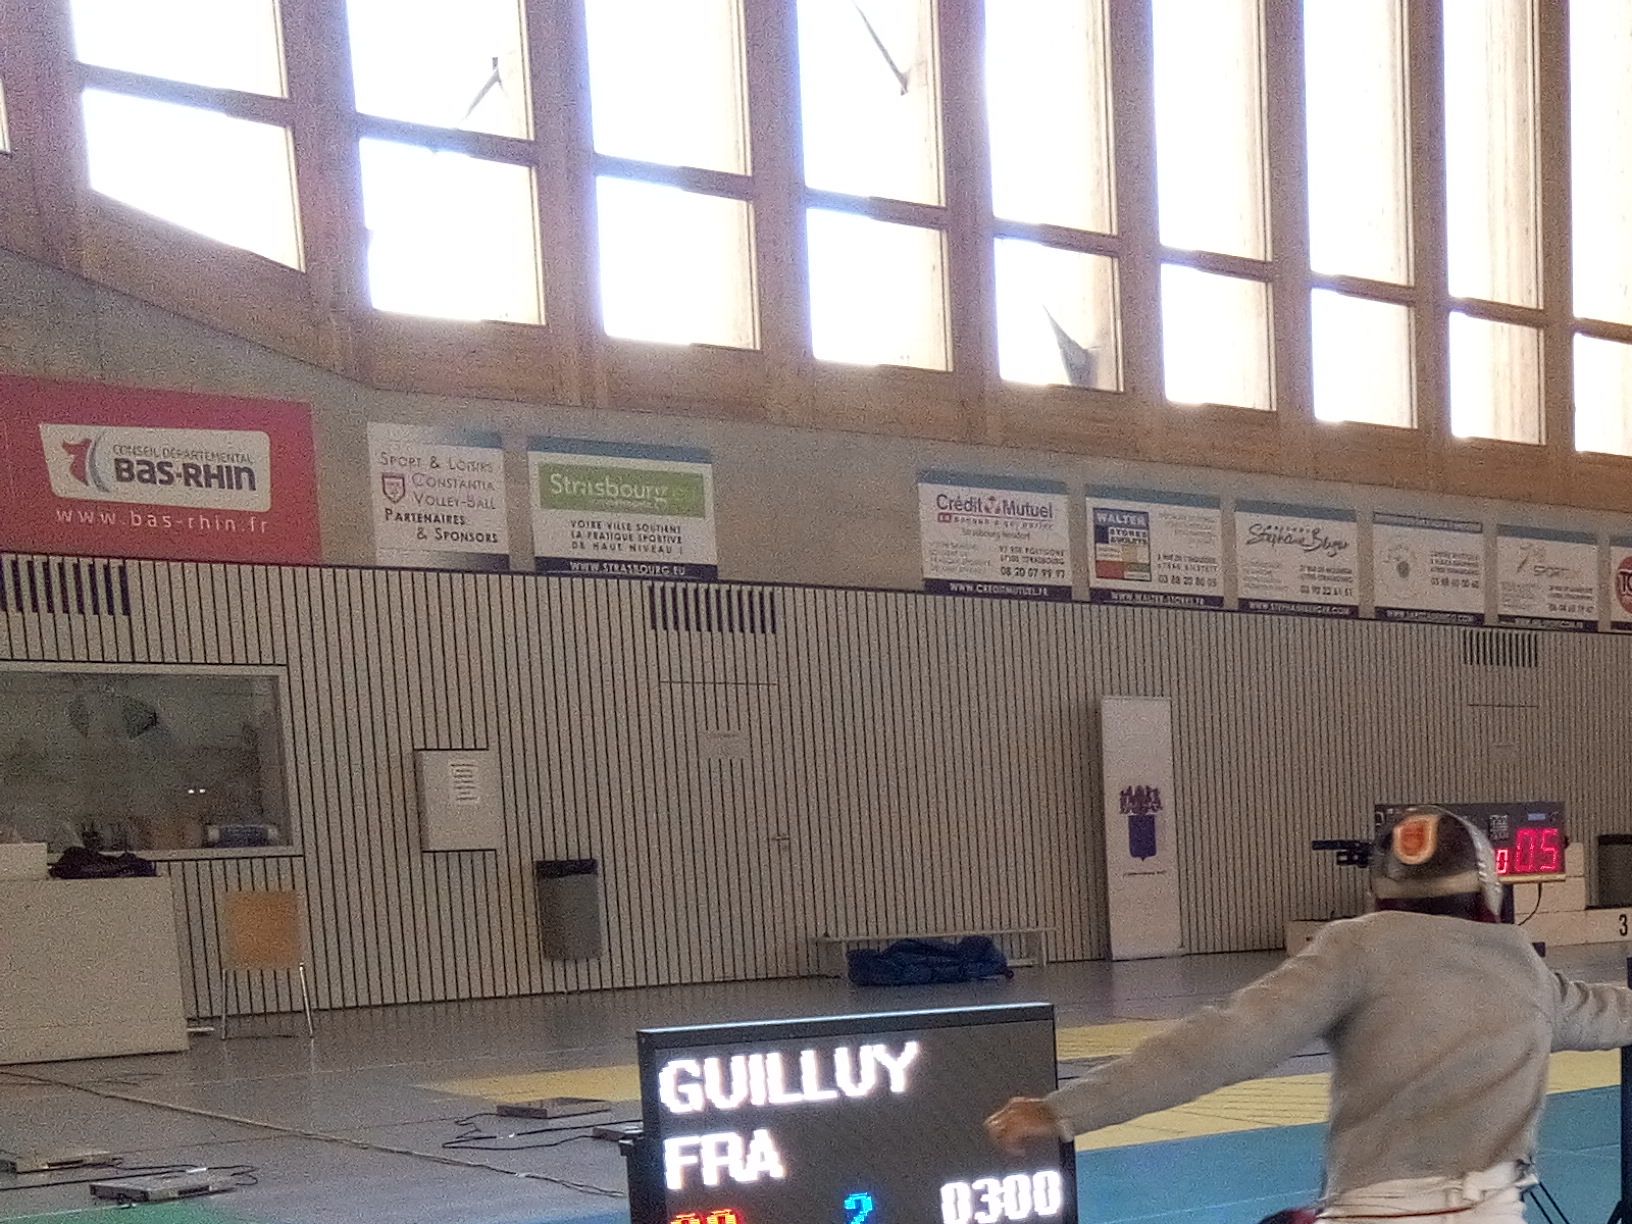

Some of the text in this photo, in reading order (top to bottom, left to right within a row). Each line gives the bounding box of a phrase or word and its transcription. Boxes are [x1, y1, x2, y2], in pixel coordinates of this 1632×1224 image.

[411, 492, 497, 510] VOLLEY-BALL
[550, 473, 668, 514] Strasbourg
[385, 508, 466, 526] PARTENAIRES
[936, 494, 1053, 519] Crédit Mutuel
[56, 510, 268, 534] www.bas-rhin.fr
[606, 522, 633, 532] VILLE
[416, 527, 499, 544] & SPONSORS
[1515, 827, 1559, 873] 05
[1618, 913, 1629, 936] 3
[658, 1041, 920, 1114] GUILLUY
[663, 1128, 787, 1190] FRA
